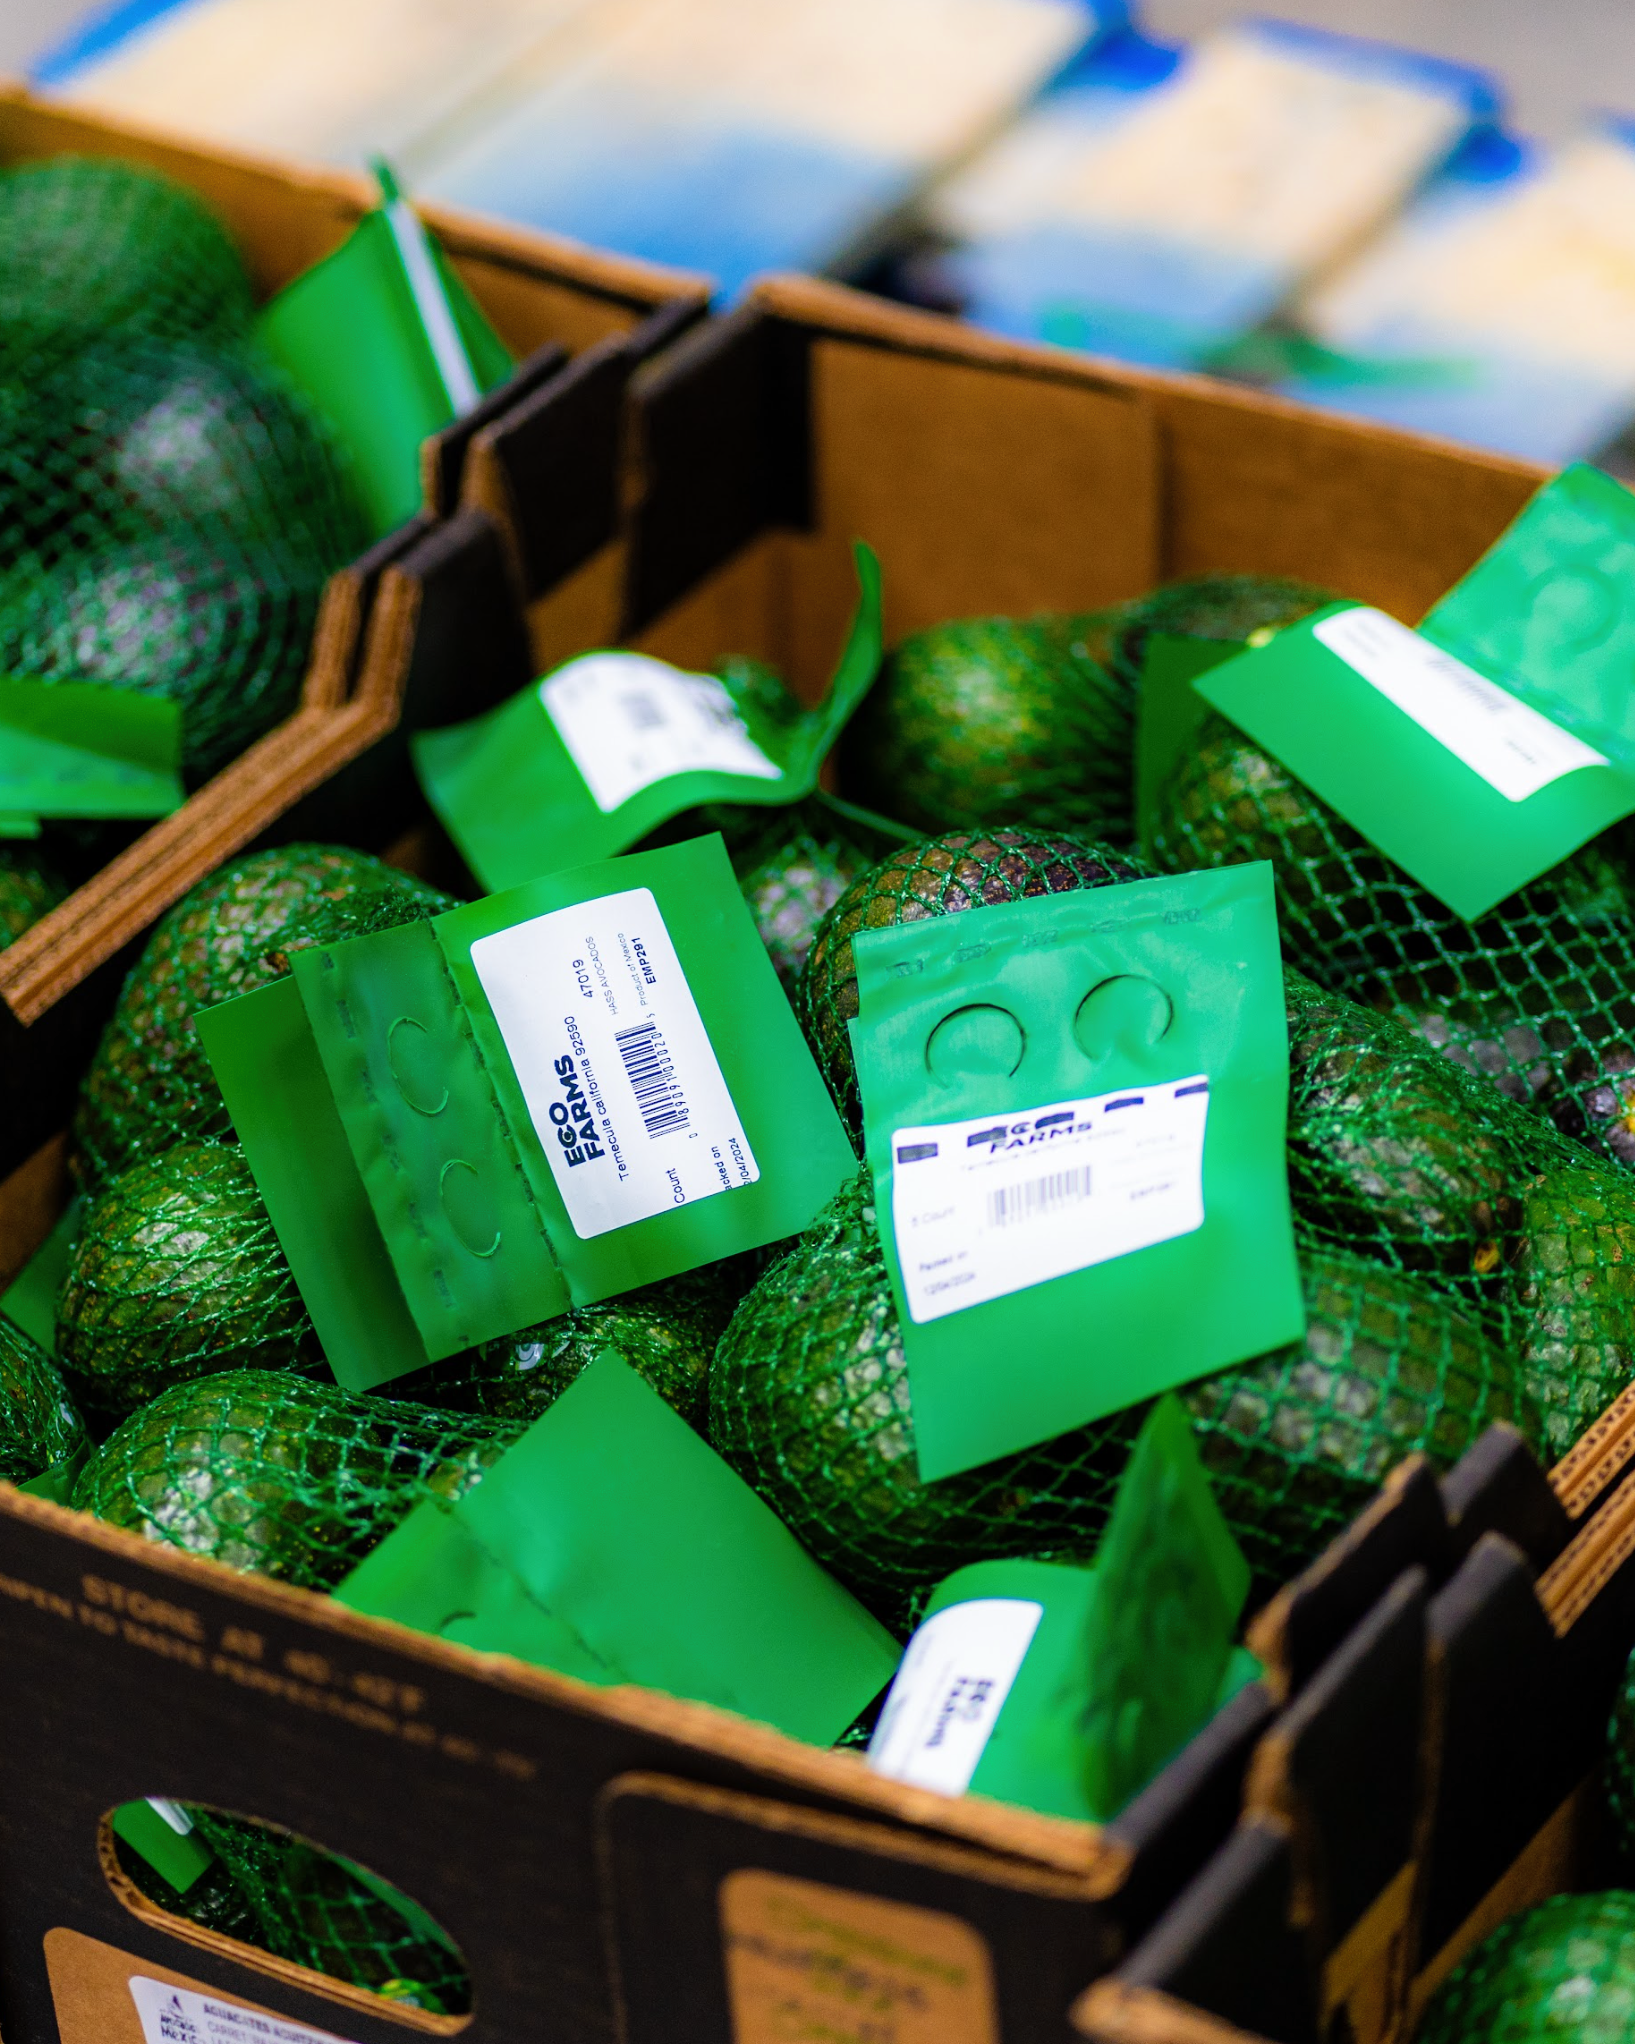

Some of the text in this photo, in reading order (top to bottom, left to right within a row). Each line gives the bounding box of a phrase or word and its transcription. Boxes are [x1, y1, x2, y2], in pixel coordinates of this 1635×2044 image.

[617, 932, 633, 963] Mexico
[630, 937, 657, 985] EMP291
[572, 958, 594, 998] 47019
[585, 935, 618, 1016] HASS AVOCADOS
[631, 973, 649, 1006] Product
[563, 1015, 586, 1056] 92590
[553, 1054, 606, 1161] FARMS
[549, 1101, 587, 1168] ECO
[601, 1117, 629, 1182] Temecula
[989, 1120, 1093, 1154] FARMS
[711, 1145, 733, 1191] acked on
[728, 1137, 753, 1186] 2/04/2024
[665, 1167, 686, 1204] Count
